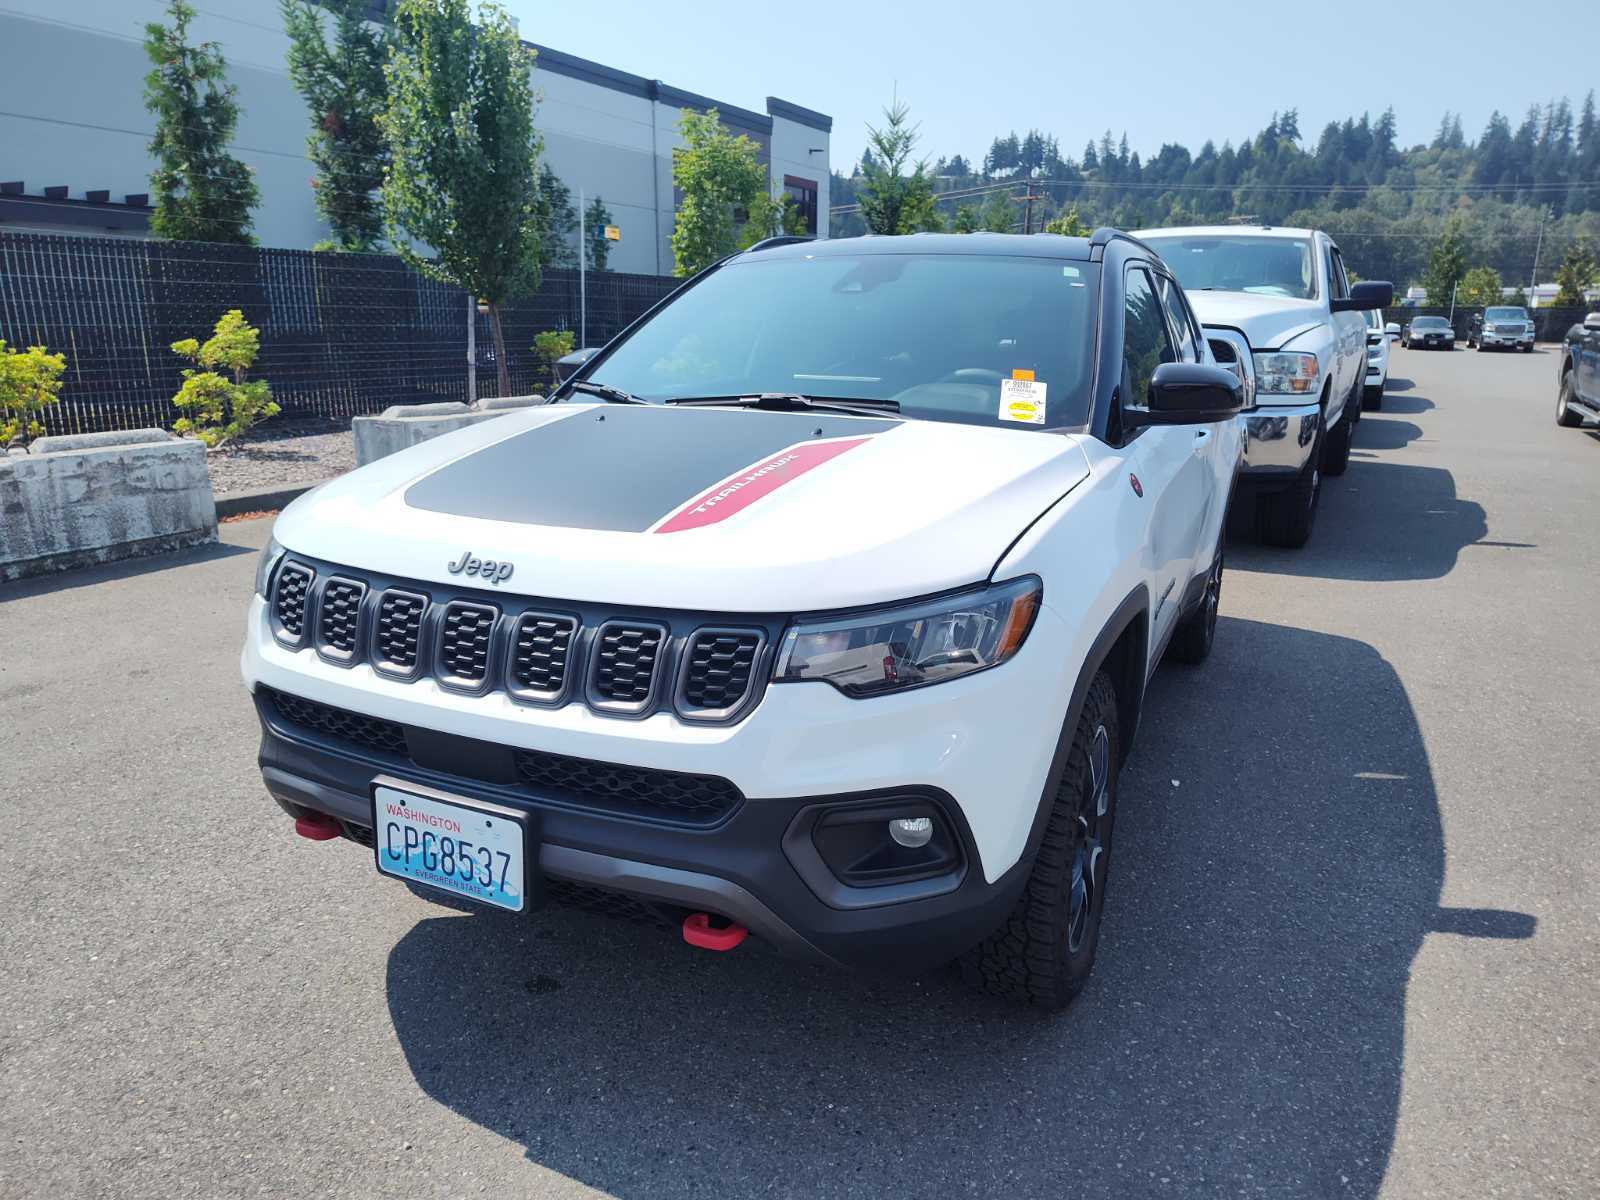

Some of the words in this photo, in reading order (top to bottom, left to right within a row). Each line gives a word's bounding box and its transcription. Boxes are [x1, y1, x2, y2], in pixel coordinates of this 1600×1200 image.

[448, 551, 514, 584] Jeep
[387, 804, 460, 832] WASHINGTON
[388, 822, 511, 892] CPG8537
[415, 869, 459, 886] EVERGREEN
[460, 882, 481, 894] STATE
